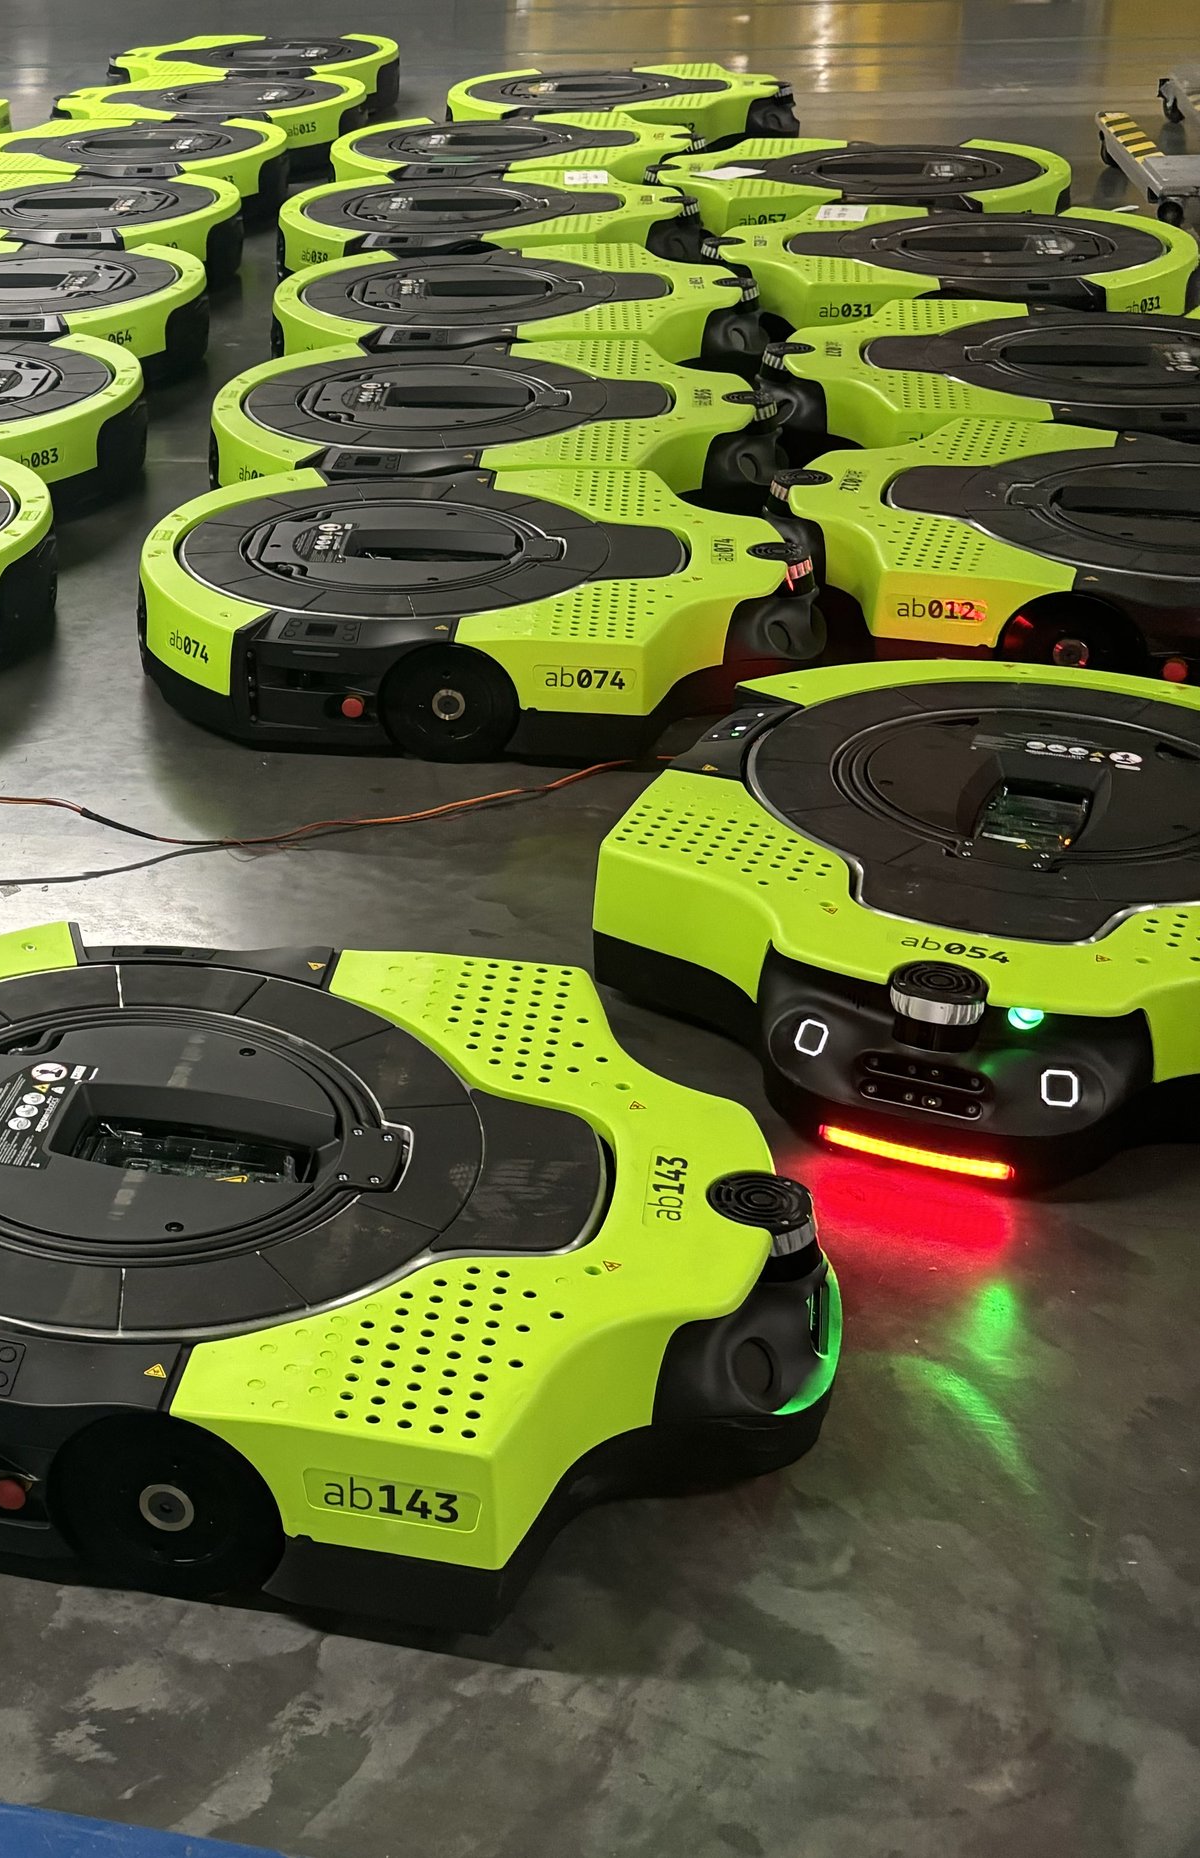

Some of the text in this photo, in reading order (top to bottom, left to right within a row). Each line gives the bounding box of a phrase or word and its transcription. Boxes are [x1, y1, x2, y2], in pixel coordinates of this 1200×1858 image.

[287, 122, 317, 137] ab015
[818, 303, 874, 318] ab031
[107, 329, 133, 346] 064
[20, 447, 60, 469] b083
[238, 465, 266, 482] ab0
[713, 538, 735, 562] ab074
[897, 598, 977, 621] ab012
[169, 628, 209, 664] ab074
[545, 666, 626, 691] ab074
[901, 936, 1010, 964] ab054
[647, 1154, 689, 1222] ab143
[323, 1475, 460, 1524] ab143
